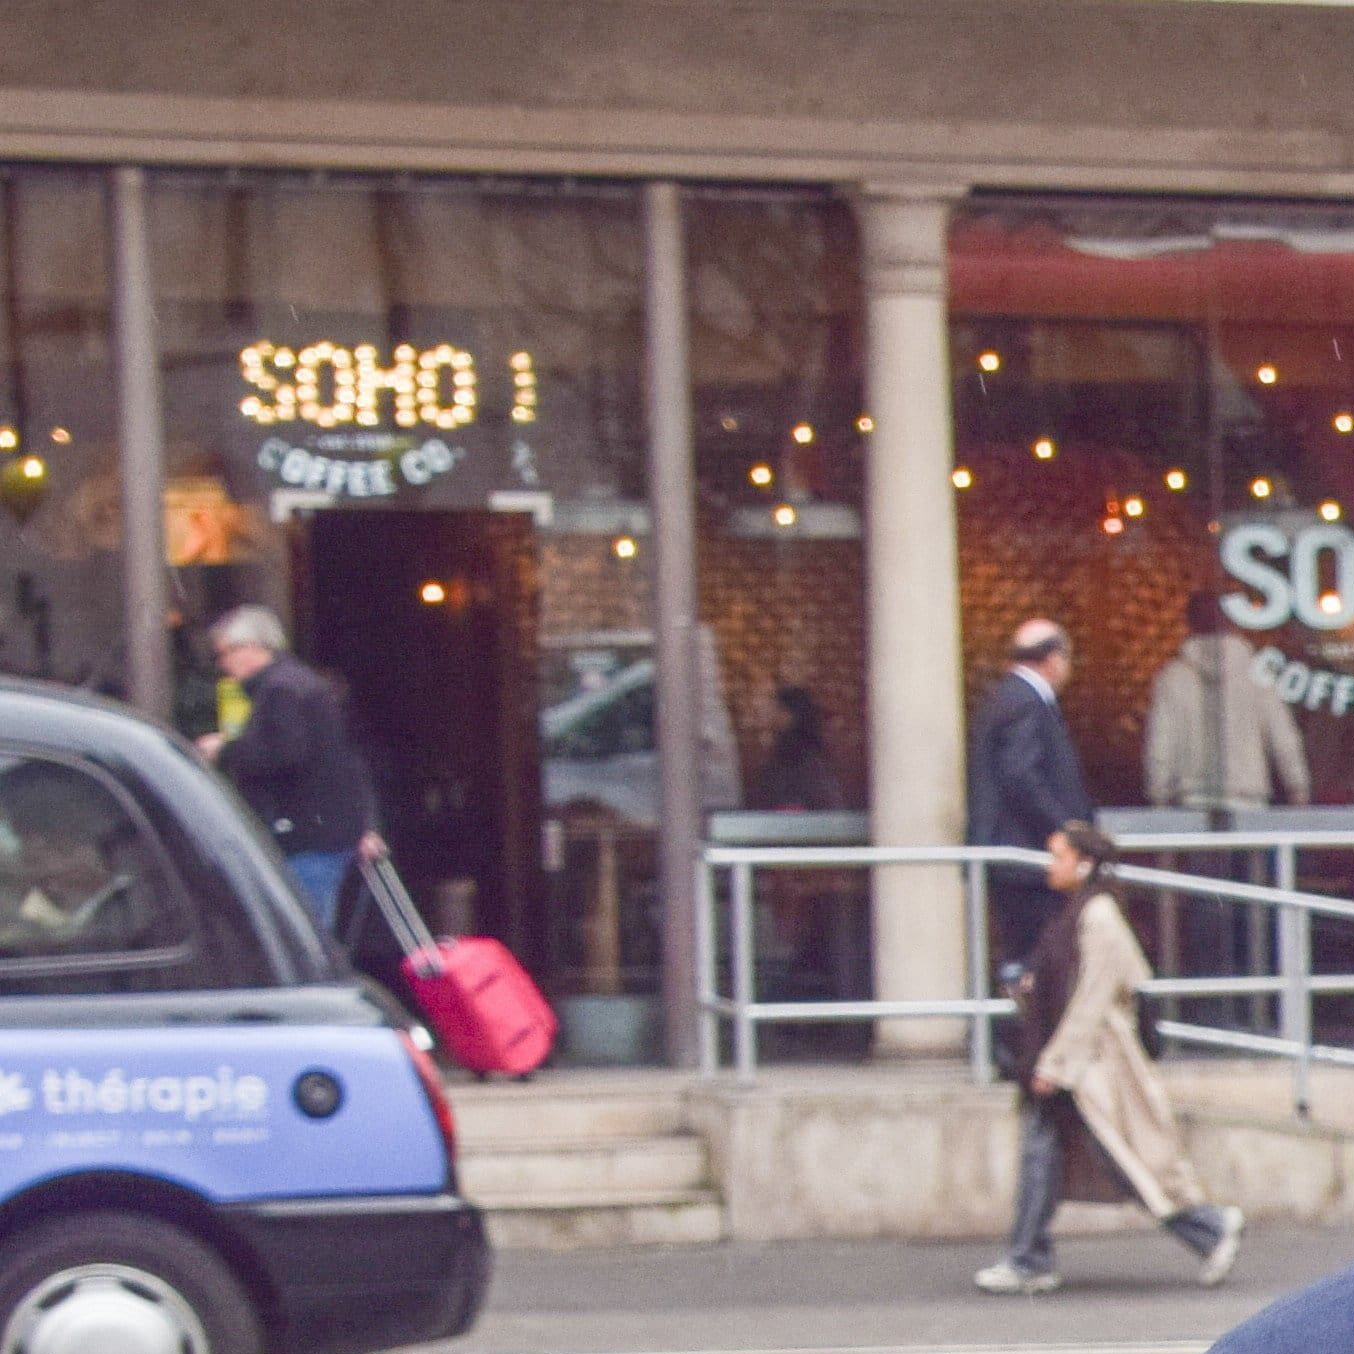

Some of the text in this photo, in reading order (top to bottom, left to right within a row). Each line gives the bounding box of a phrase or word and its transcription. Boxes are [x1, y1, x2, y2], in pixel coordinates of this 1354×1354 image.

[239, 339, 476, 428] SOHO
[257, 437, 397, 497] COFFEE
[42, 1066, 268, 1122] thérapie
